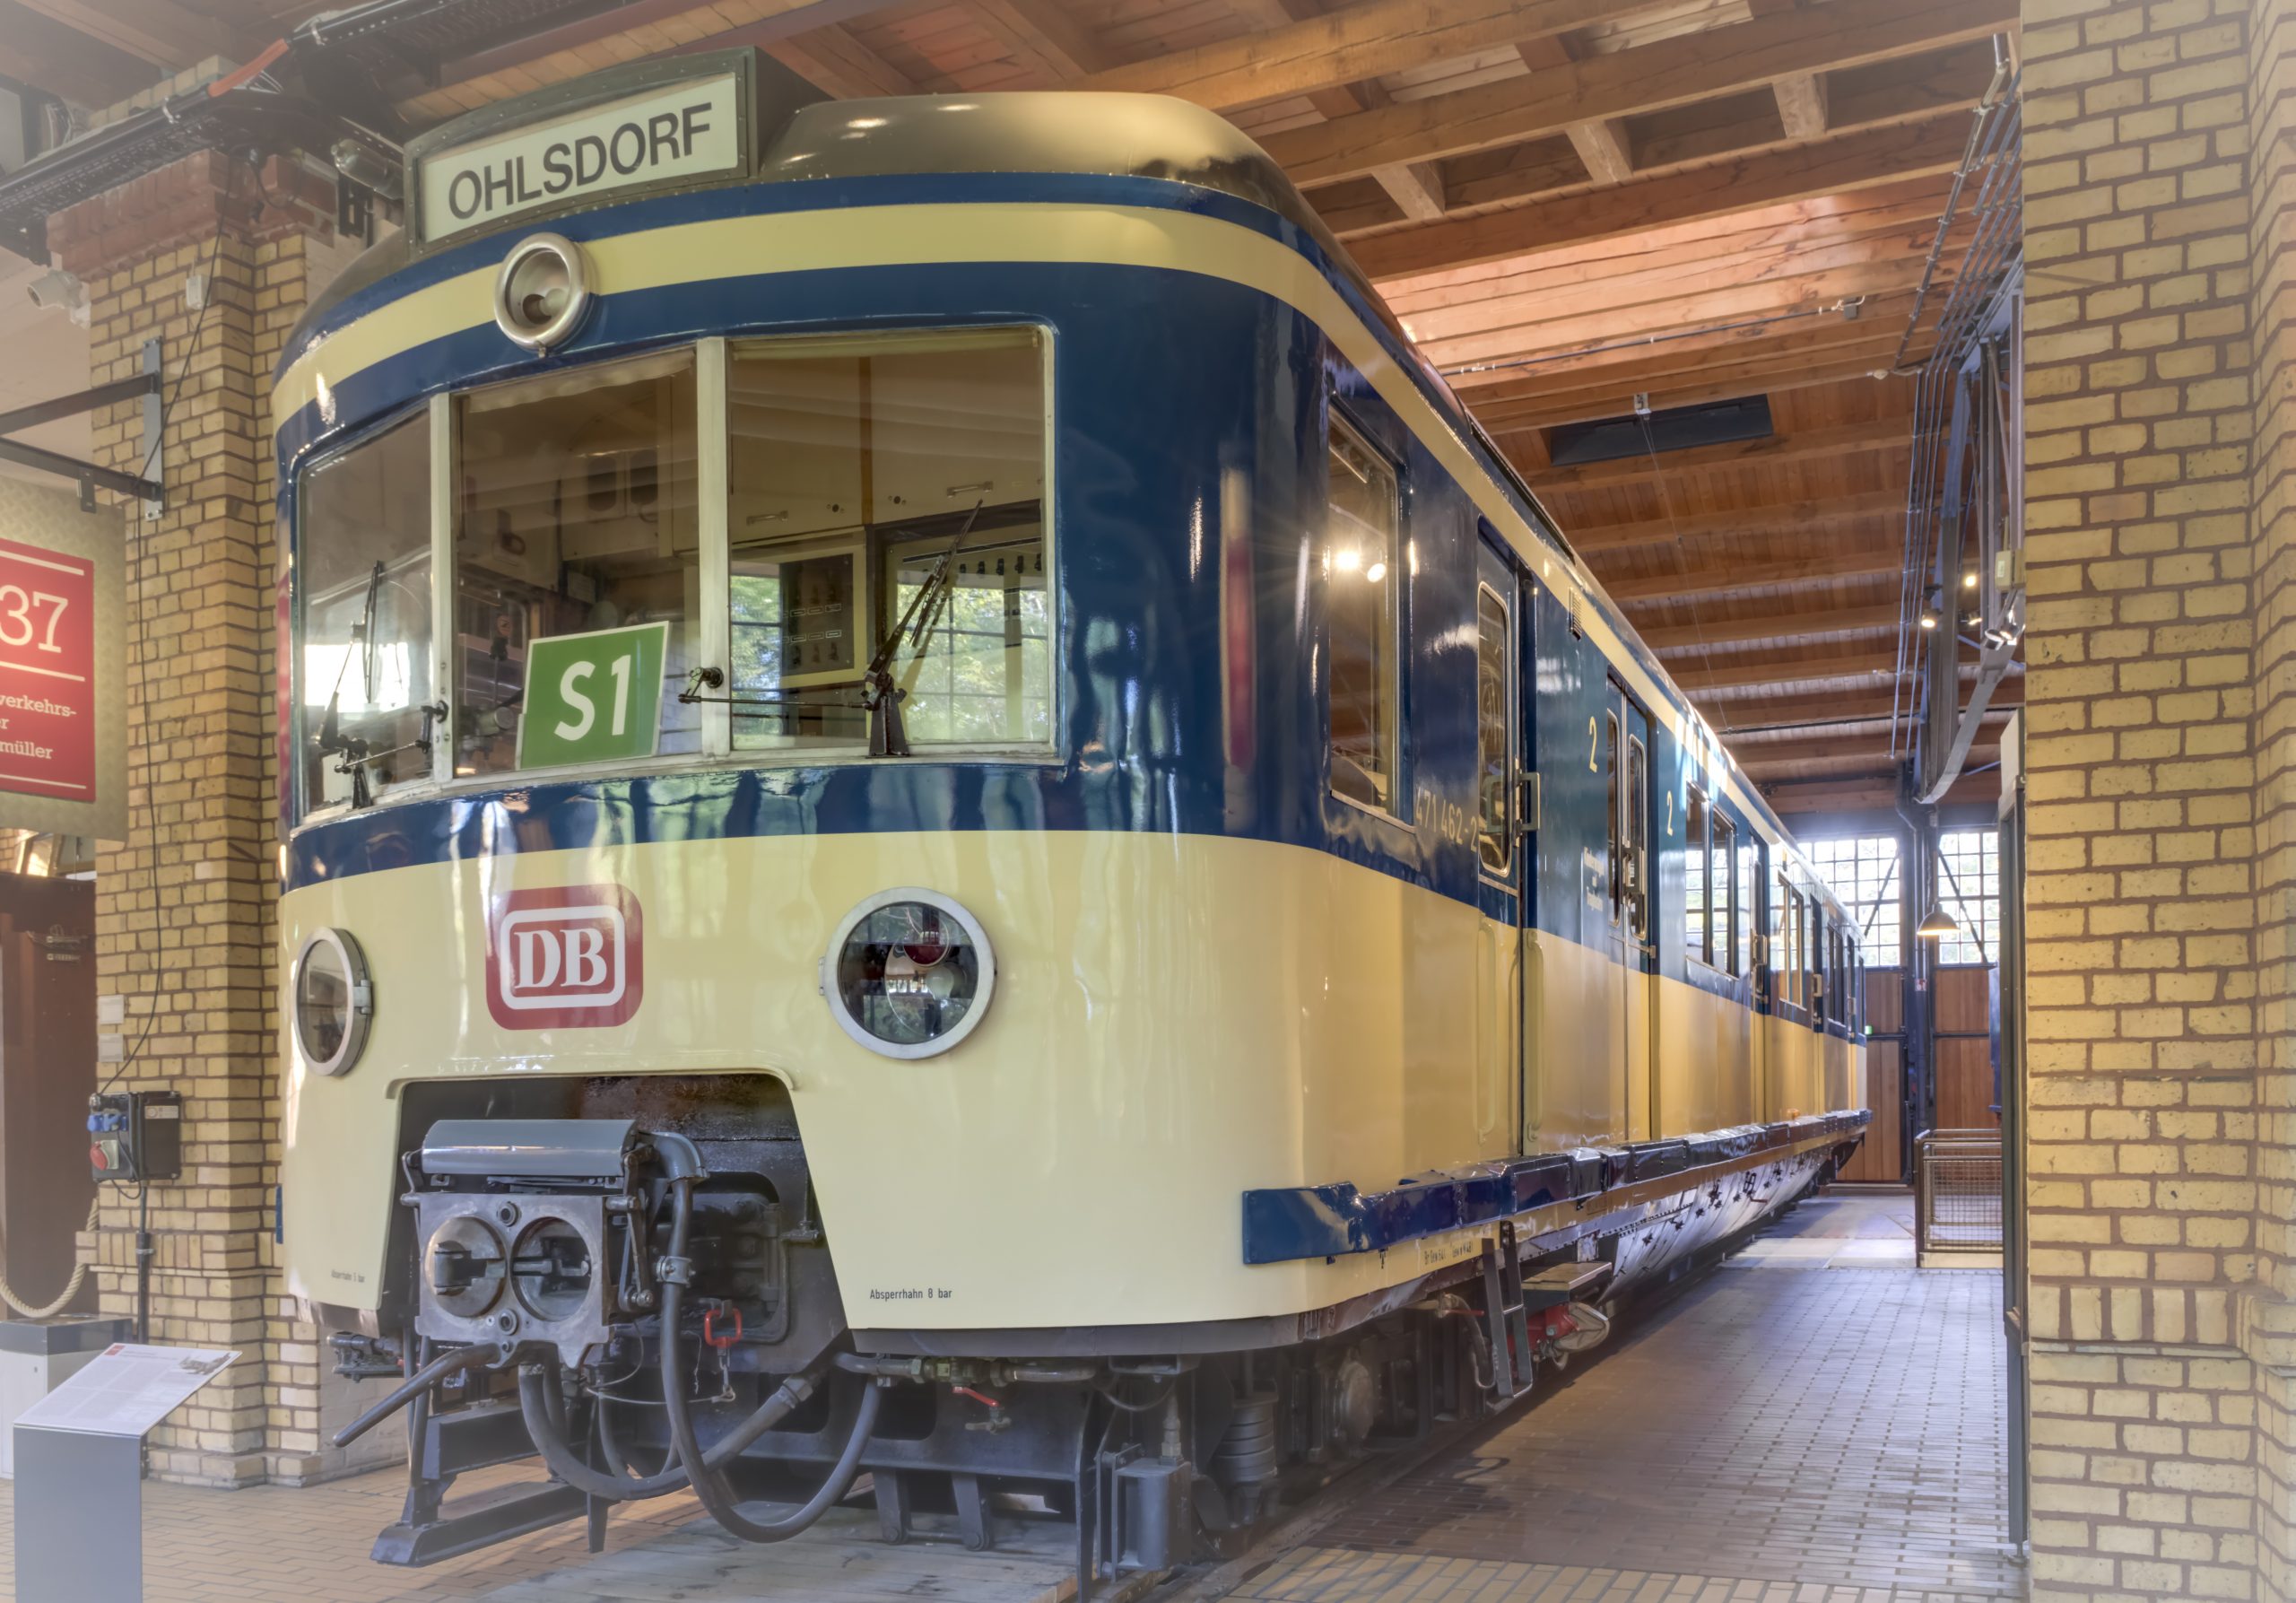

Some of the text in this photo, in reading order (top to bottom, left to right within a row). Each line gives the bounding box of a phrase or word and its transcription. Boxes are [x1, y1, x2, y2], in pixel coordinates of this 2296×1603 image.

[448, 101, 711, 220] OHLSDORF
[0, 584, 68, 653] 37
[553, 654, 631, 741] S1
[1588, 716, 1598, 773] 2
[1415, 786, 1437, 832] 471
[1666, 789, 1674, 836] 2
[514, 928, 607, 989] DB
[870, 1287, 952, 1302] Absperrhahn 8 bar
